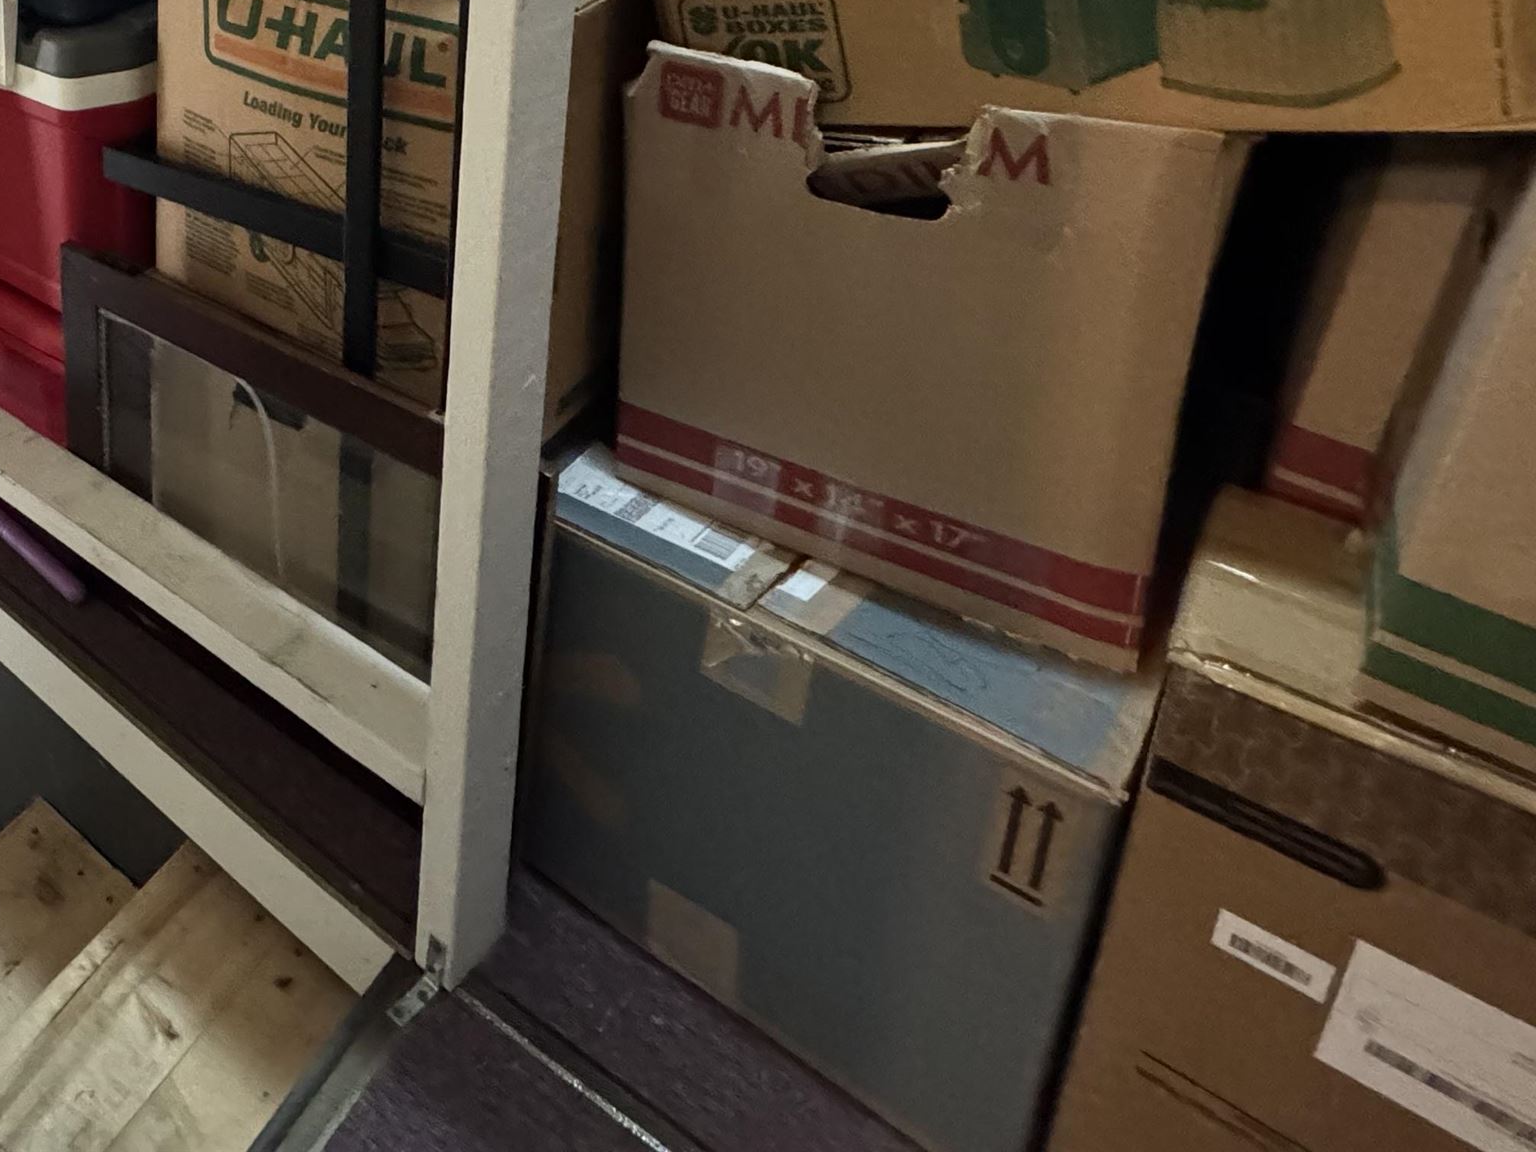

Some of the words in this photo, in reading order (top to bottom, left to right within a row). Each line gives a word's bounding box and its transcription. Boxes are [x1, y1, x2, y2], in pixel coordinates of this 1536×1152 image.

[725, 17, 829, 34] BOXES
[243, 91, 302, 129] Loading
[309, 114, 347, 139] Your
